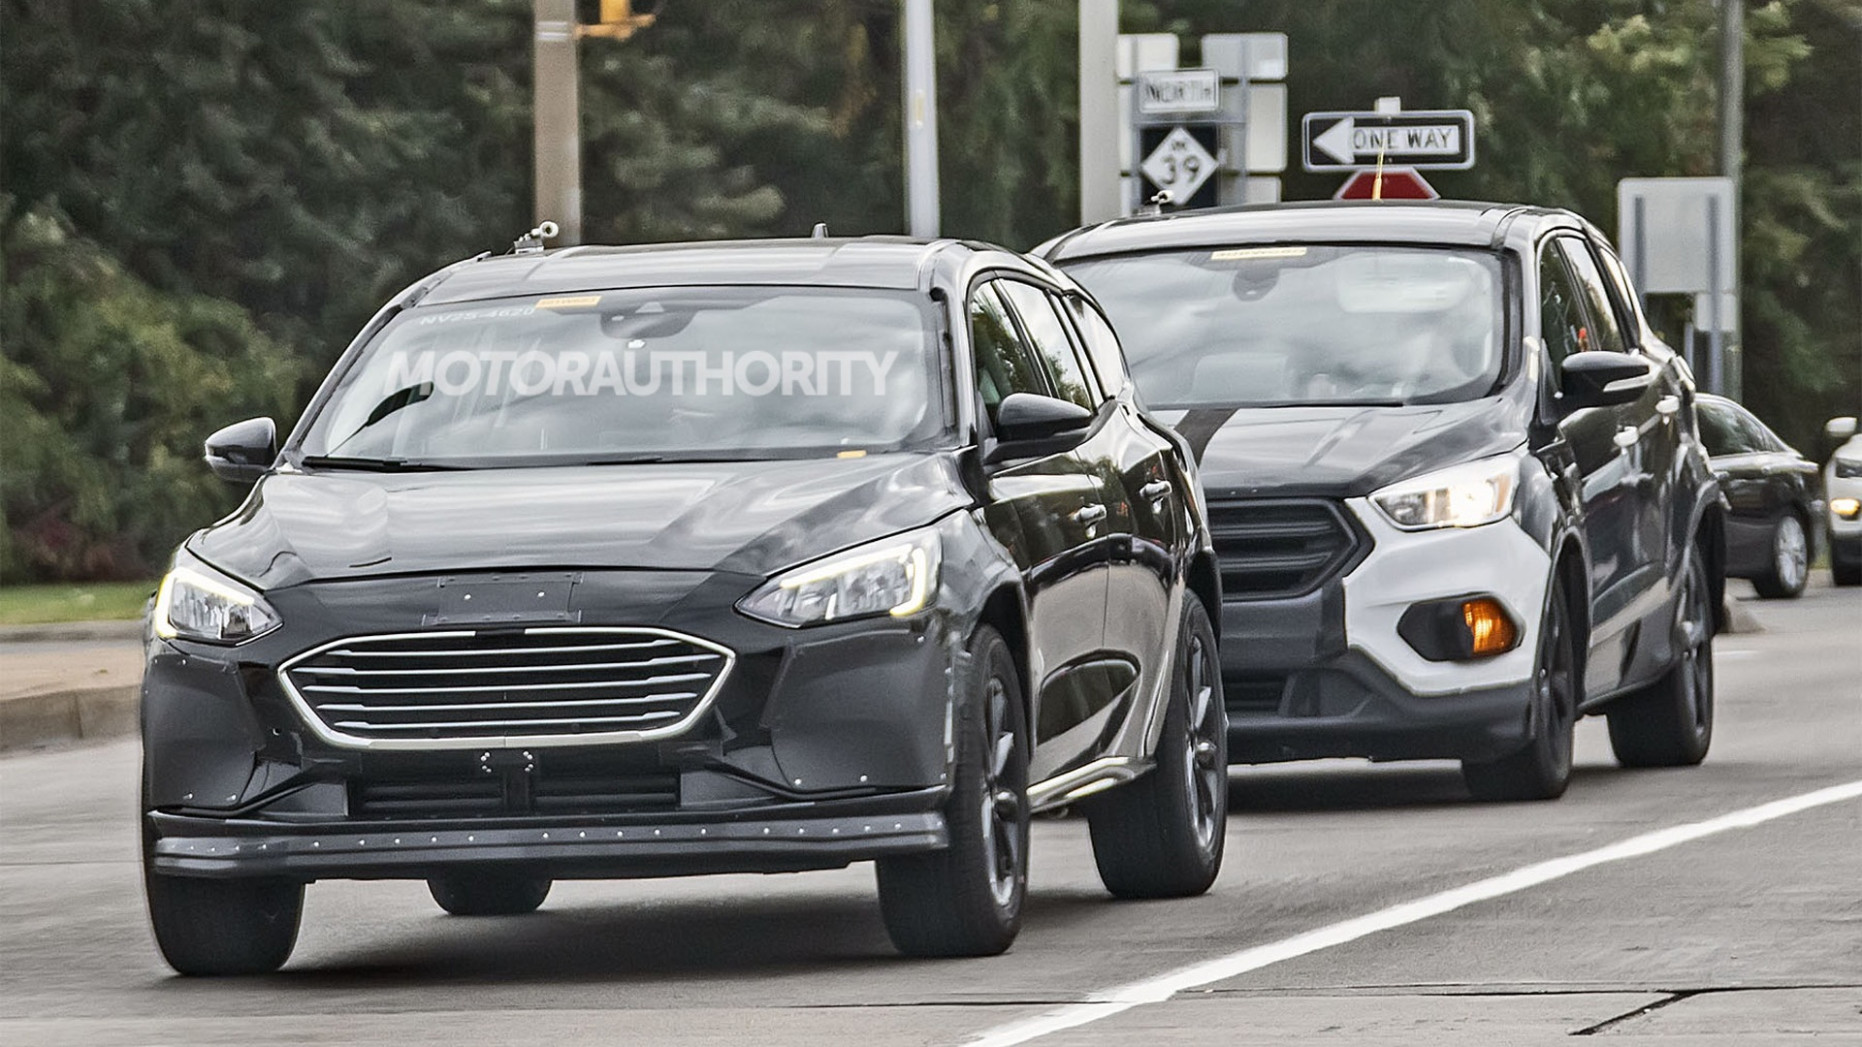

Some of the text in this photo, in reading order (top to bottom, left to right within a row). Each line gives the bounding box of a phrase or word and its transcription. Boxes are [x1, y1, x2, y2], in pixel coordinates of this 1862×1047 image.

[1353, 128, 1452, 149] ONE WAY
[1162, 154, 1200, 185] 39
